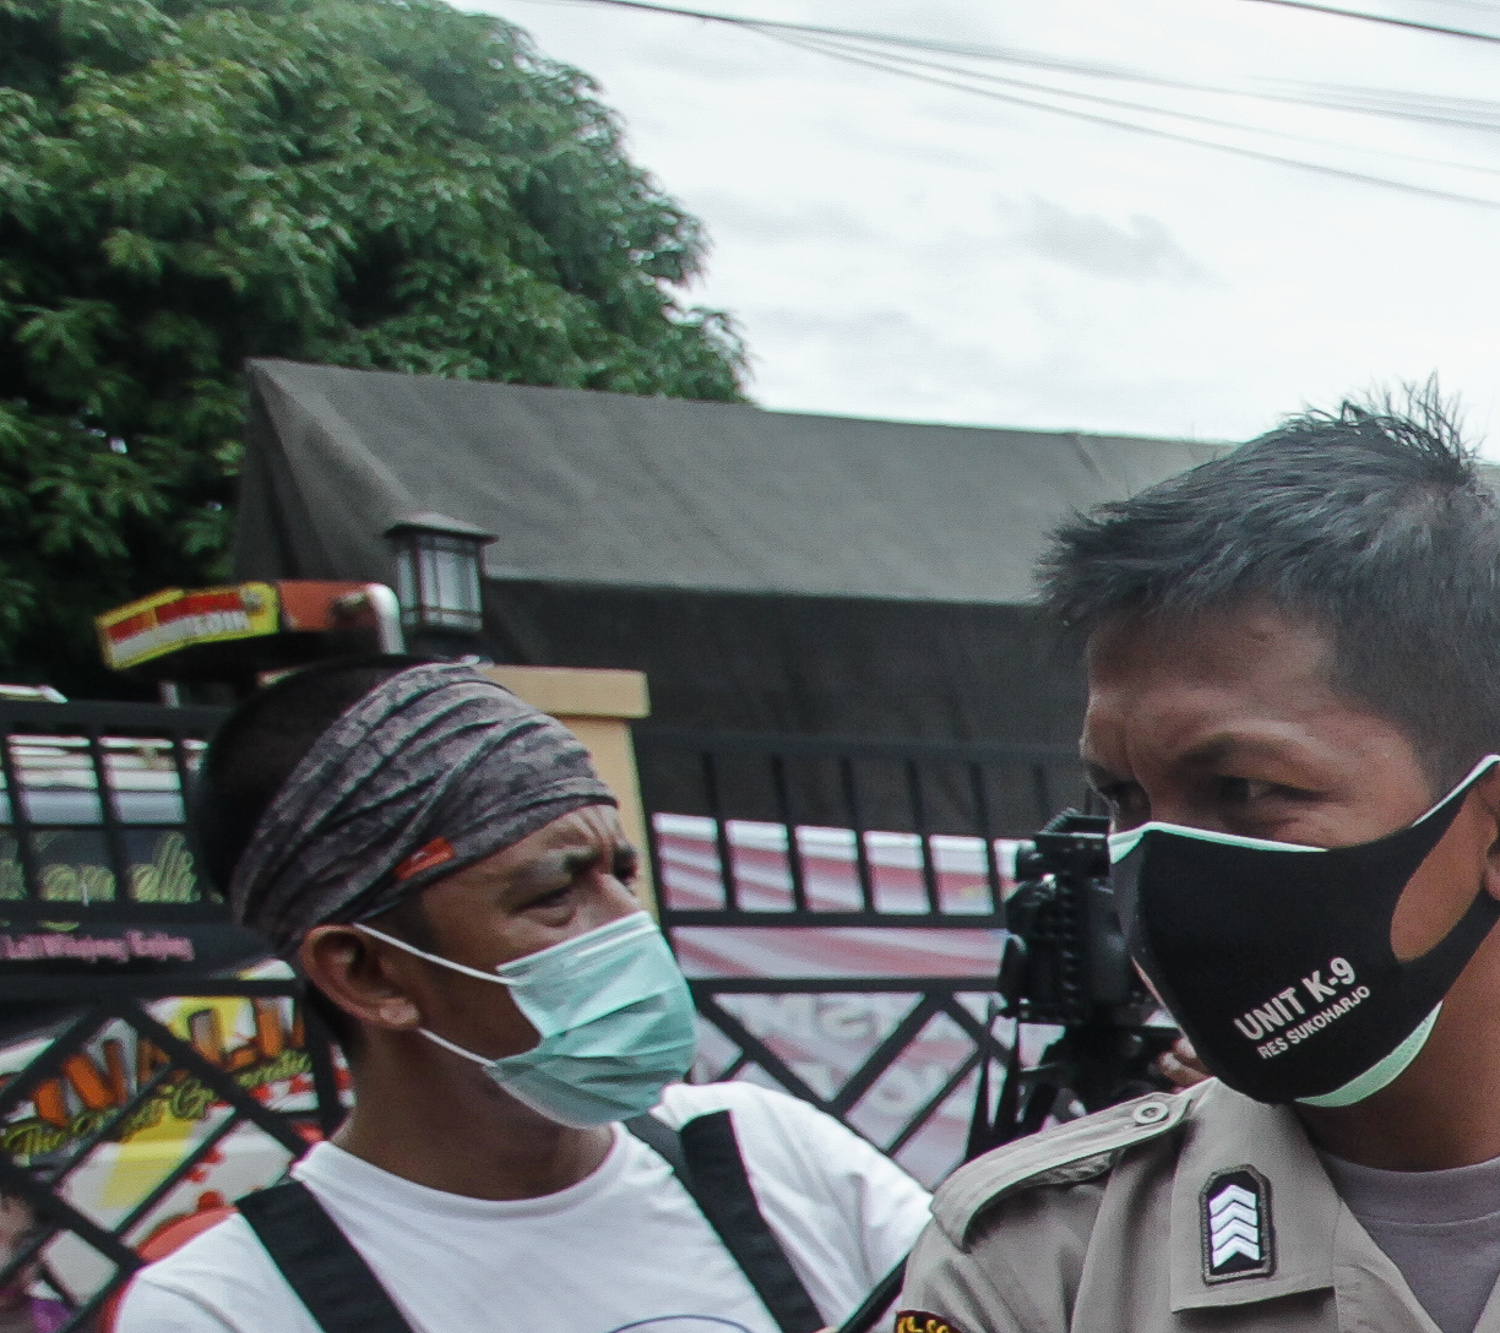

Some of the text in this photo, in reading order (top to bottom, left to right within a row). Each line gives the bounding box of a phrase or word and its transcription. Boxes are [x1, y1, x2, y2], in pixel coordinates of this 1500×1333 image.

[1233, 956, 1357, 1041] UNIT K-9
[1256, 985, 1371, 1060] RES SUKOHARJO
